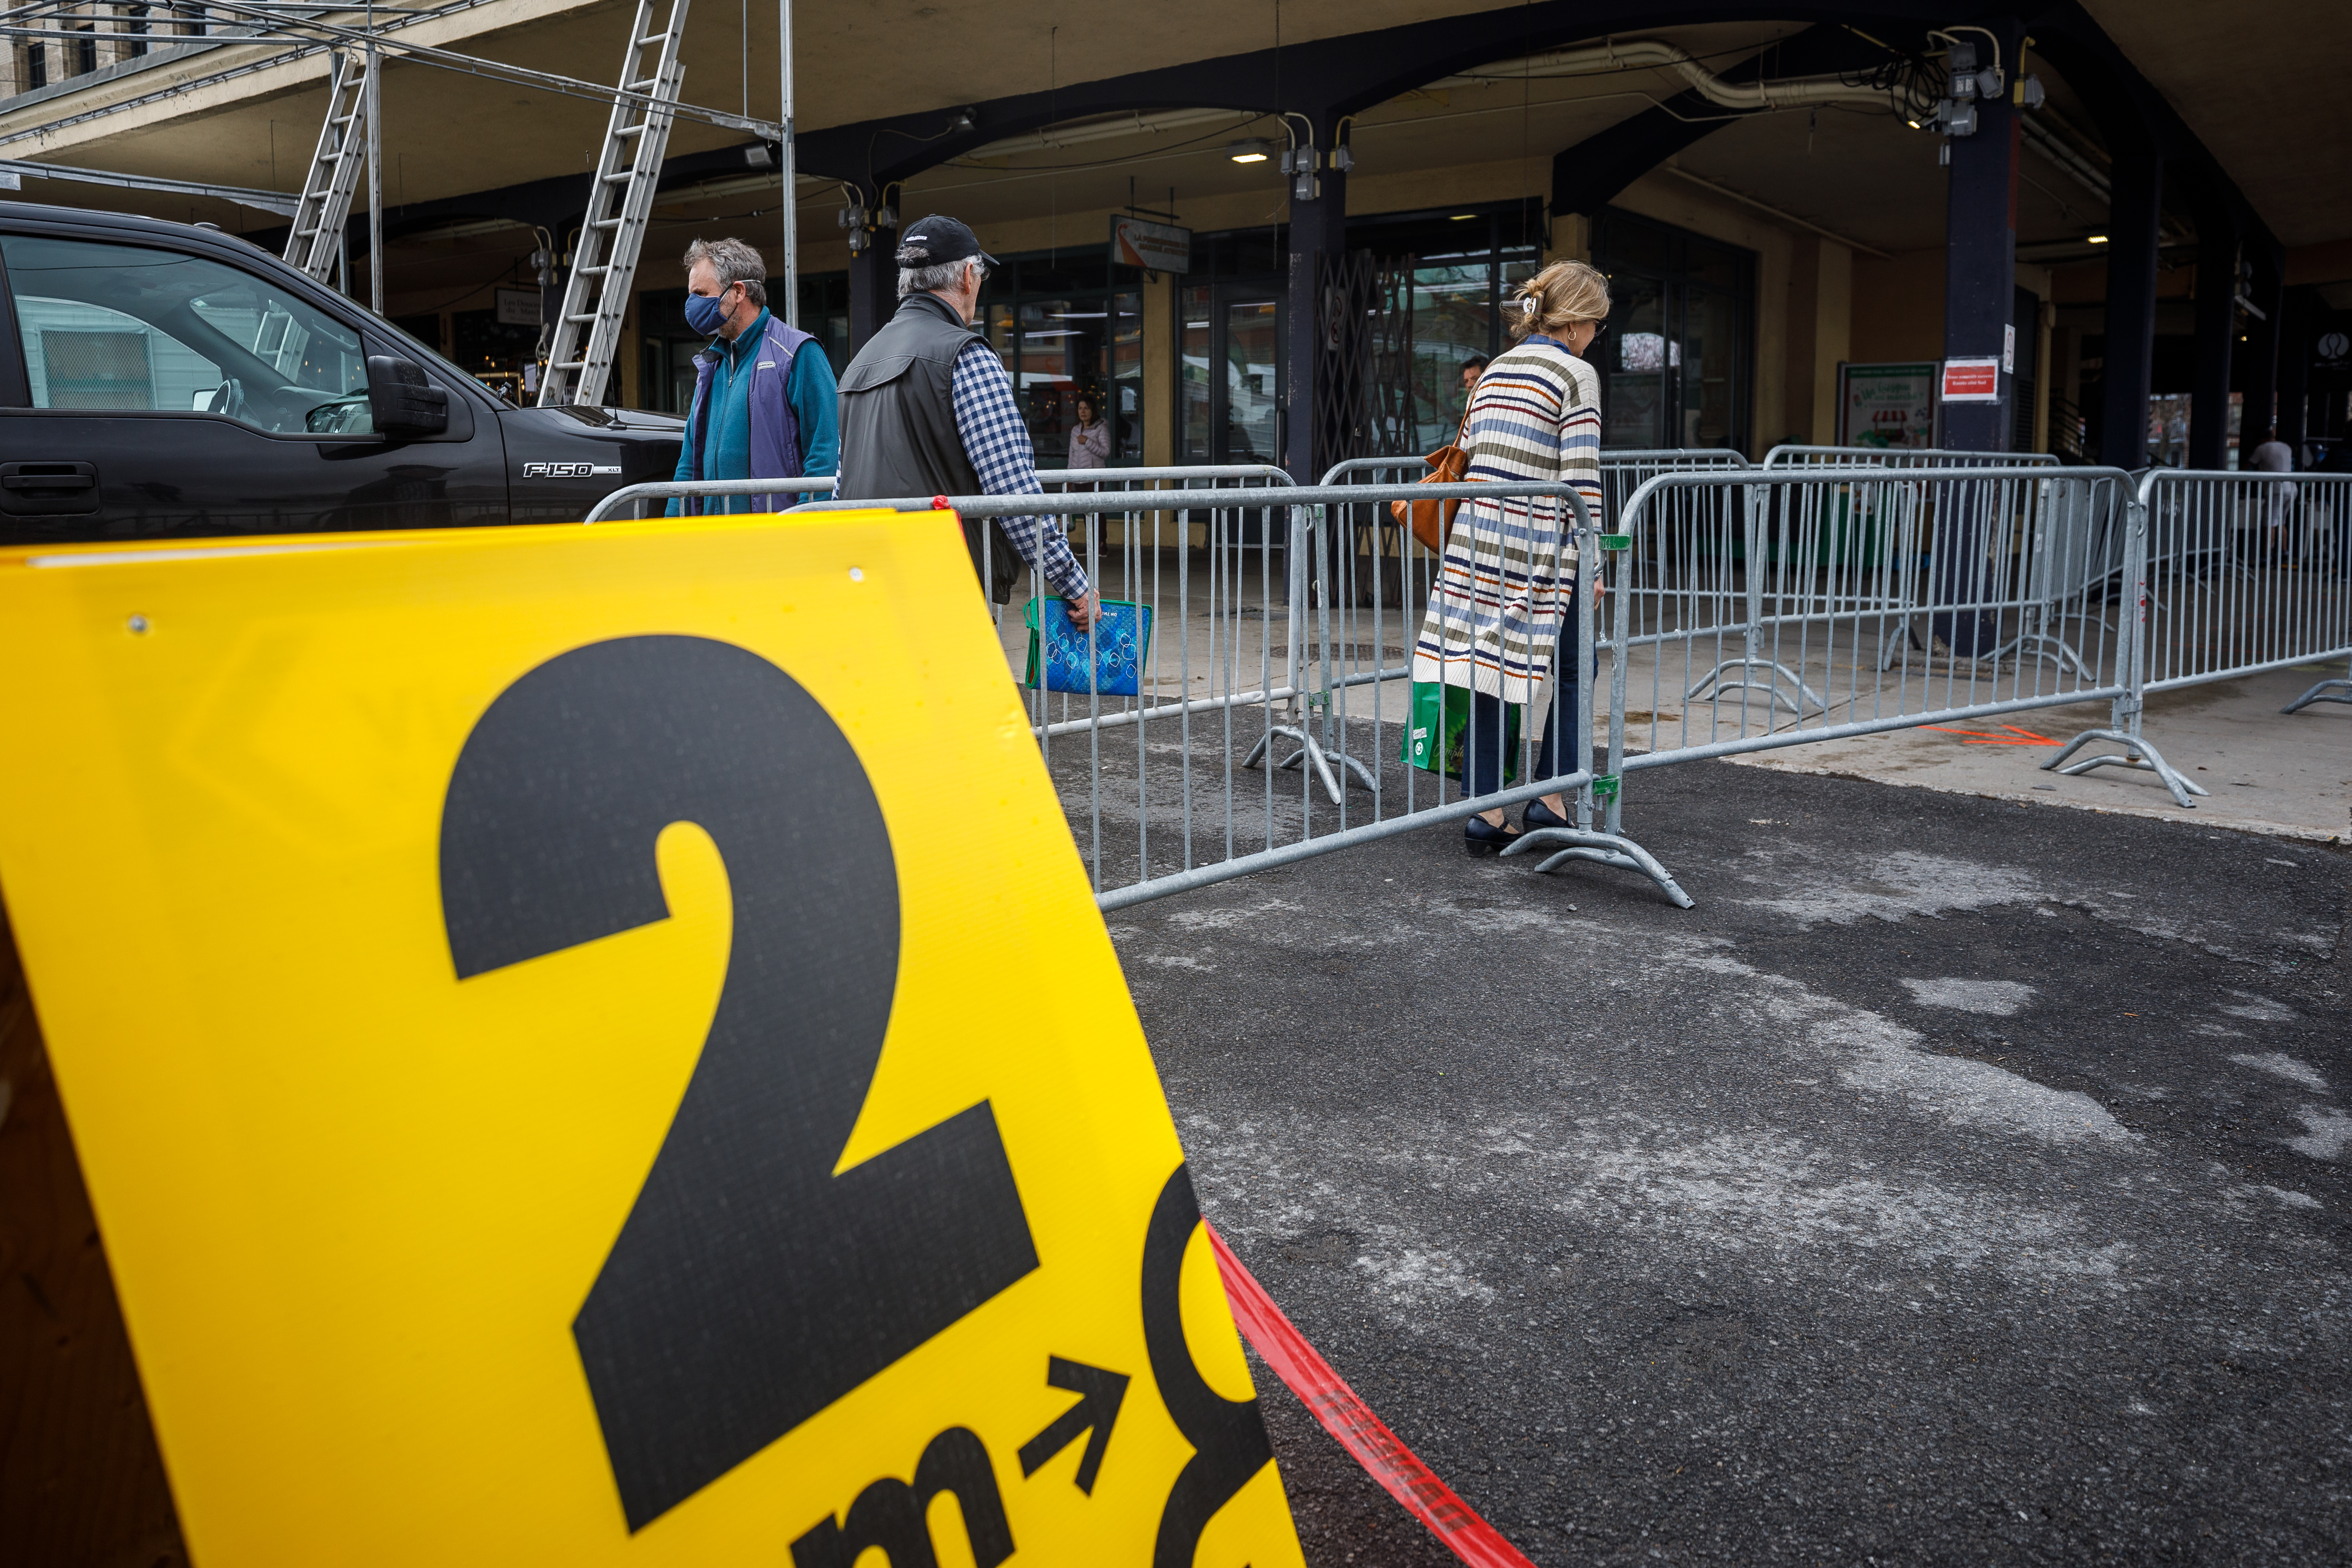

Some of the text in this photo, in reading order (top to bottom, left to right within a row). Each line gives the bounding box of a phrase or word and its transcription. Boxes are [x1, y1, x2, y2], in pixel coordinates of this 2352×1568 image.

[522, 462, 594, 478] F-150
[439, 634, 1040, 1536] 2
[790, 1425, 1017, 1568] m
[1311, 1389, 1478, 1534] DANGER
